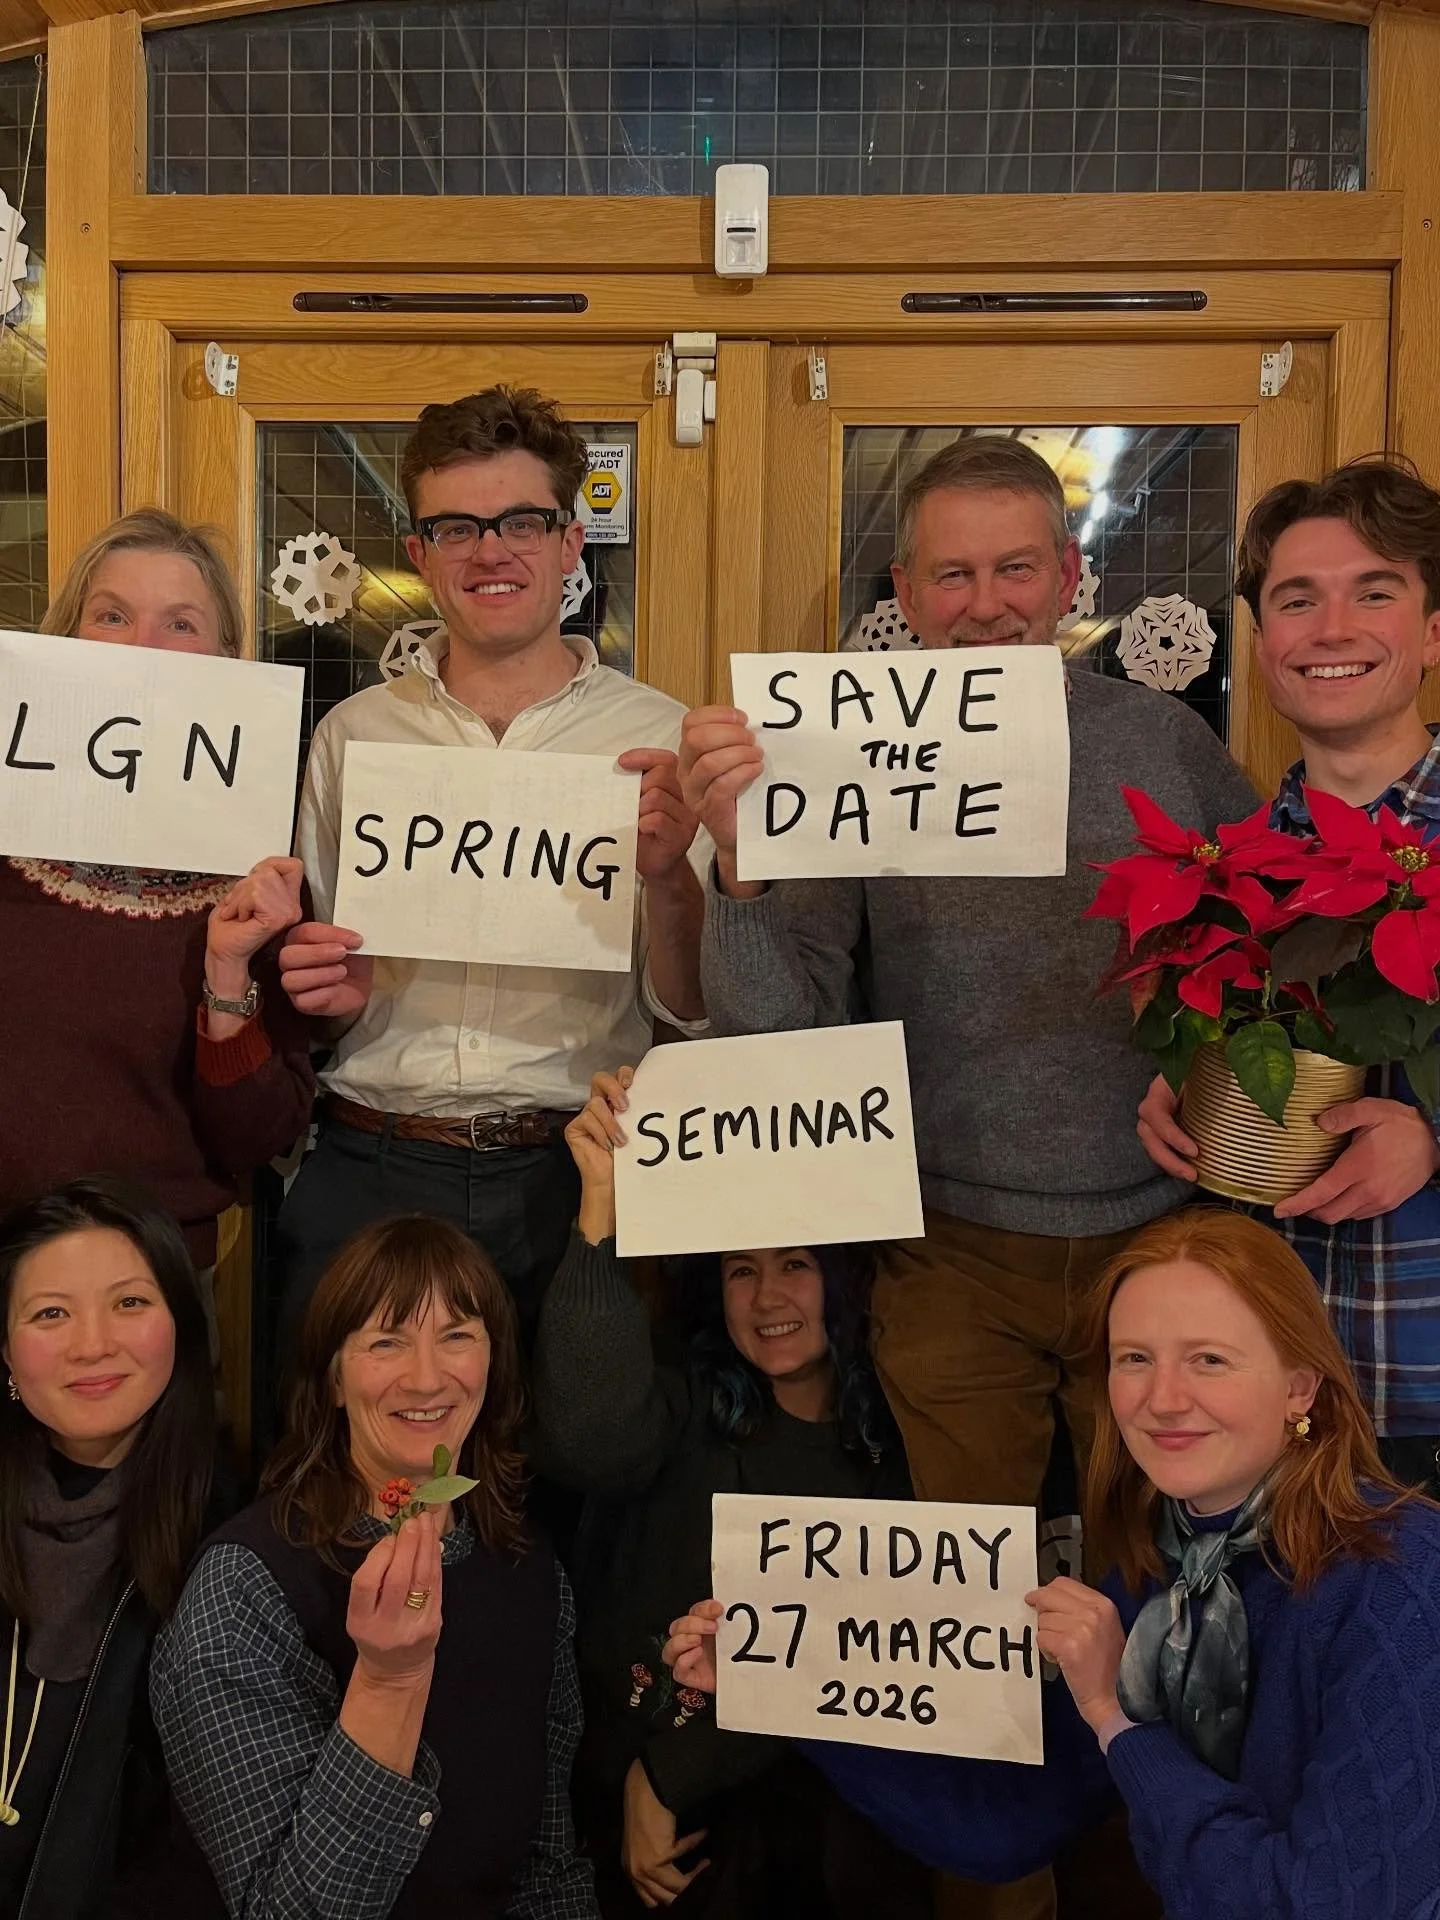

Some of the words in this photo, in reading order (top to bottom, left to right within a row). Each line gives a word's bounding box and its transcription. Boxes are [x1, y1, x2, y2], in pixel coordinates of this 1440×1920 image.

[588, 449, 623, 458] ecured
[599, 460, 620, 469] ADT
[592, 484, 611, 497] ADT
[762, 667, 1004, 732] SAVE
[5, 702, 241, 794] LGN
[860, 739, 942, 773] THE
[765, 781, 1003, 846] DATE
[354, 813, 621, 901] SPRING
[636, 1086, 895, 1167] SEMINAR
[759, 1518, 1012, 1591] FRIDAY
[725, 1602, 807, 1669] 27
[837, 1617, 1034, 1679] MARCH
[816, 1679, 937, 1726] 2026
